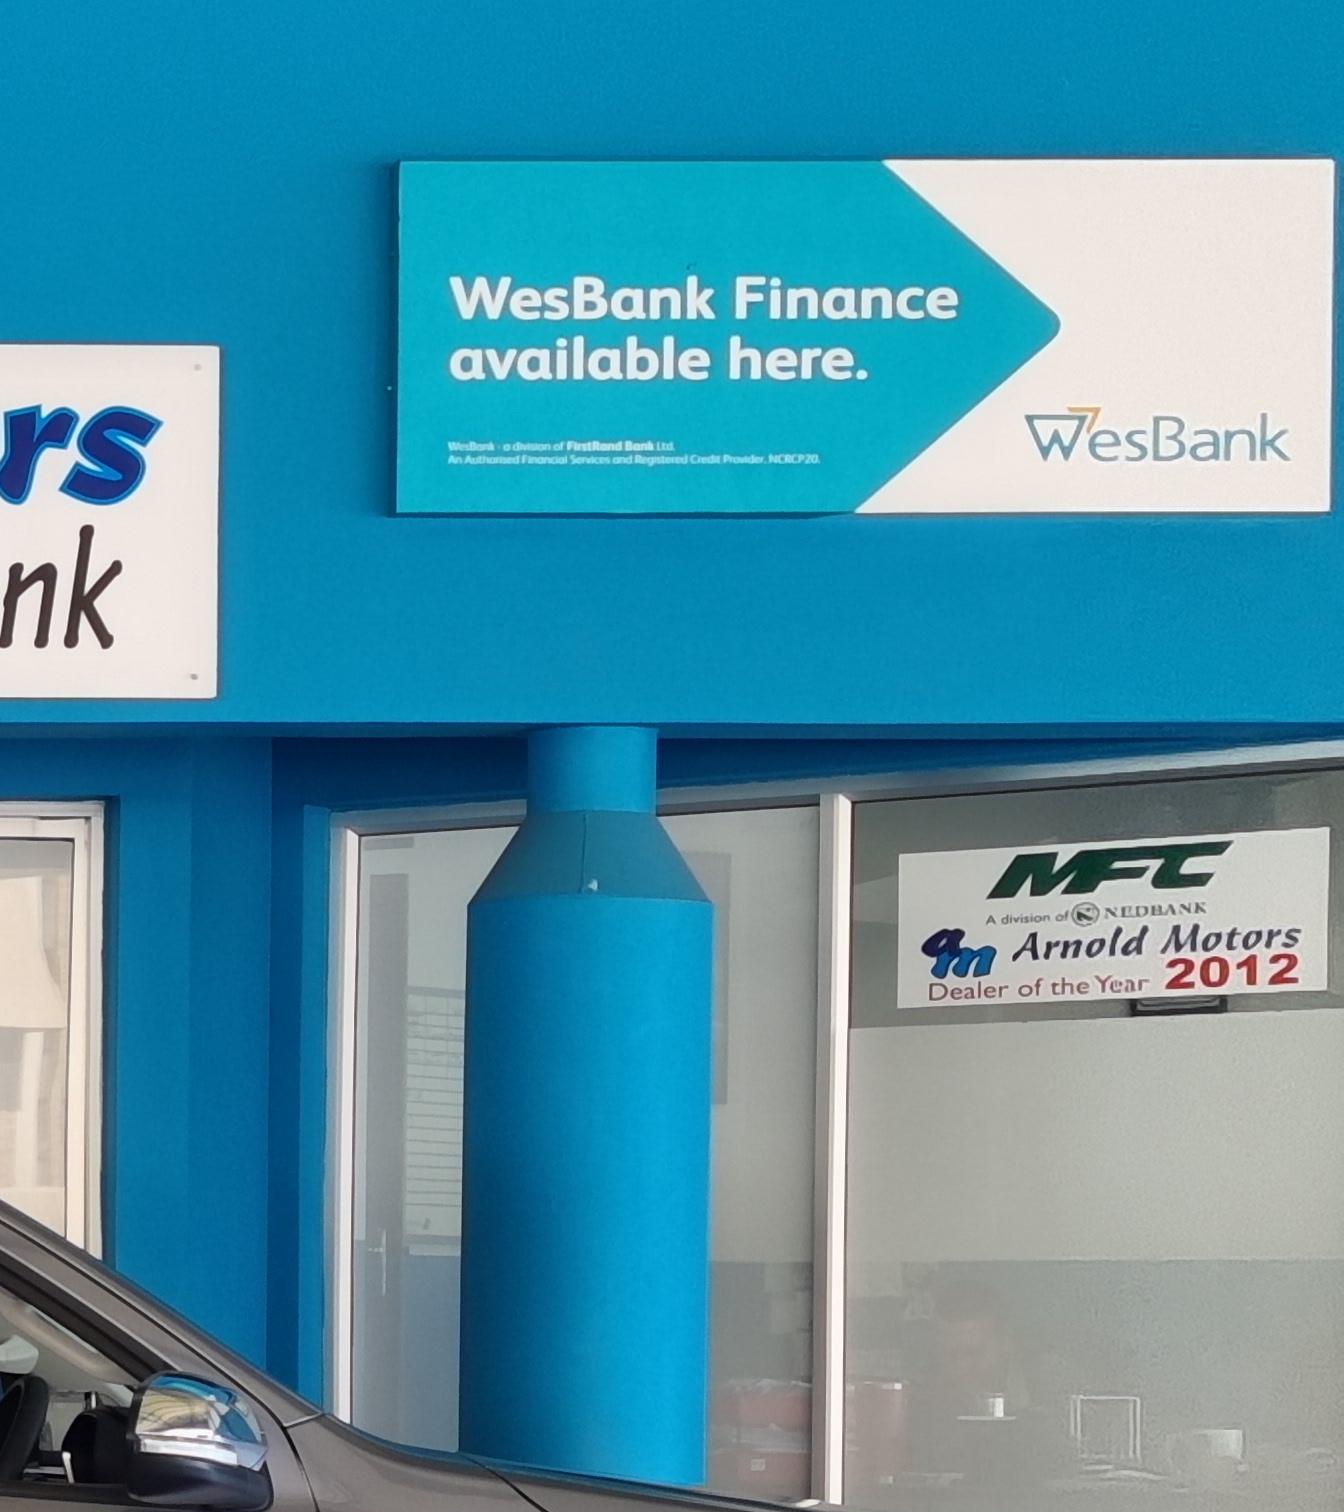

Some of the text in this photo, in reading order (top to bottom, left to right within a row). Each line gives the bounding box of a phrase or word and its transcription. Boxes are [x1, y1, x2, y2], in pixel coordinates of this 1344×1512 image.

[449, 274, 959, 322] WesBank Finance
[449, 334, 869, 382] available here.
[448, 441, 495, 452] WesBank
[512, 441, 551, 452] division
[553, 441, 565, 452] of
[567, 441, 622, 452] FirstRand
[625, 441, 654, 452] Bank
[1024, 406, 1292, 464] WesBank
[448, 455, 462, 465] An
[464, 454, 520, 465] Authorised
[522, 454, 567, 465] Financial
[569, 454, 611, 465] Services
[613, 454, 633, 465] and
[635, 454, 688, 467] Registered
[690, 454, 721, 465] Credit
[986, 840, 1234, 900] MFC
[985, 901, 1207, 926] A division of NEDBANK
[1012, 923, 1302, 963] Arnold Motors
[928, 953, 1300, 1002] Dealer of the Year 2012
